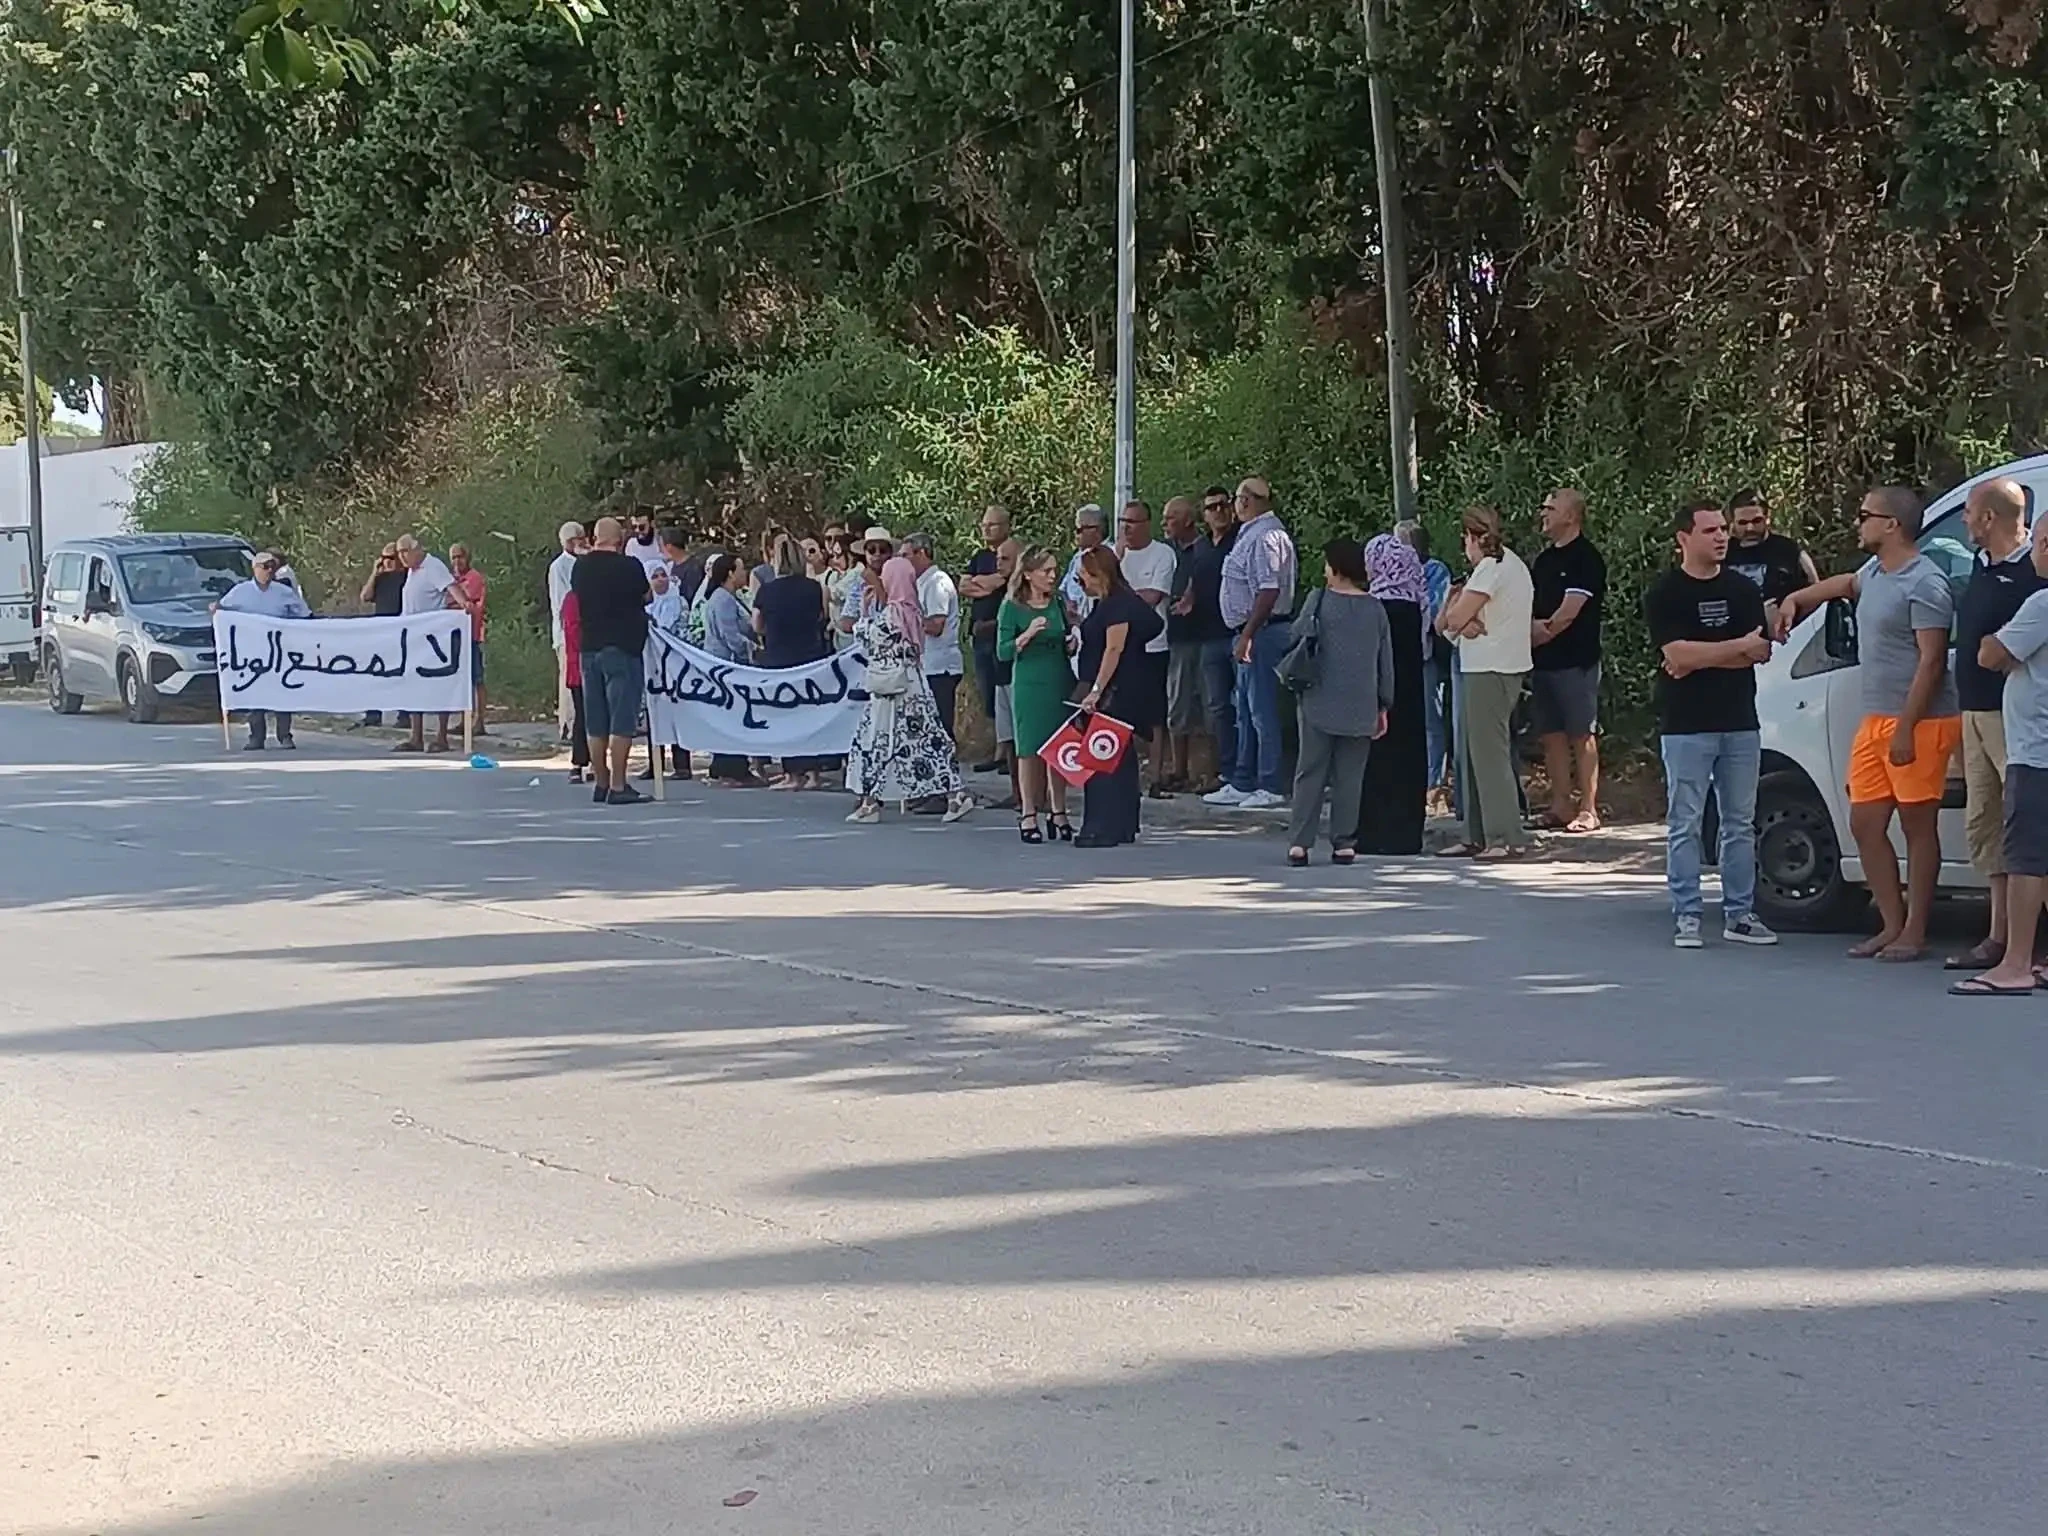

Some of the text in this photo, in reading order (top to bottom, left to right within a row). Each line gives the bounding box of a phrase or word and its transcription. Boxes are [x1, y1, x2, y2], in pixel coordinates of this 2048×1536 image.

[219, 625, 461, 692] لا لمصنع الوباء
[733, 657, 848, 729] لمصنع
